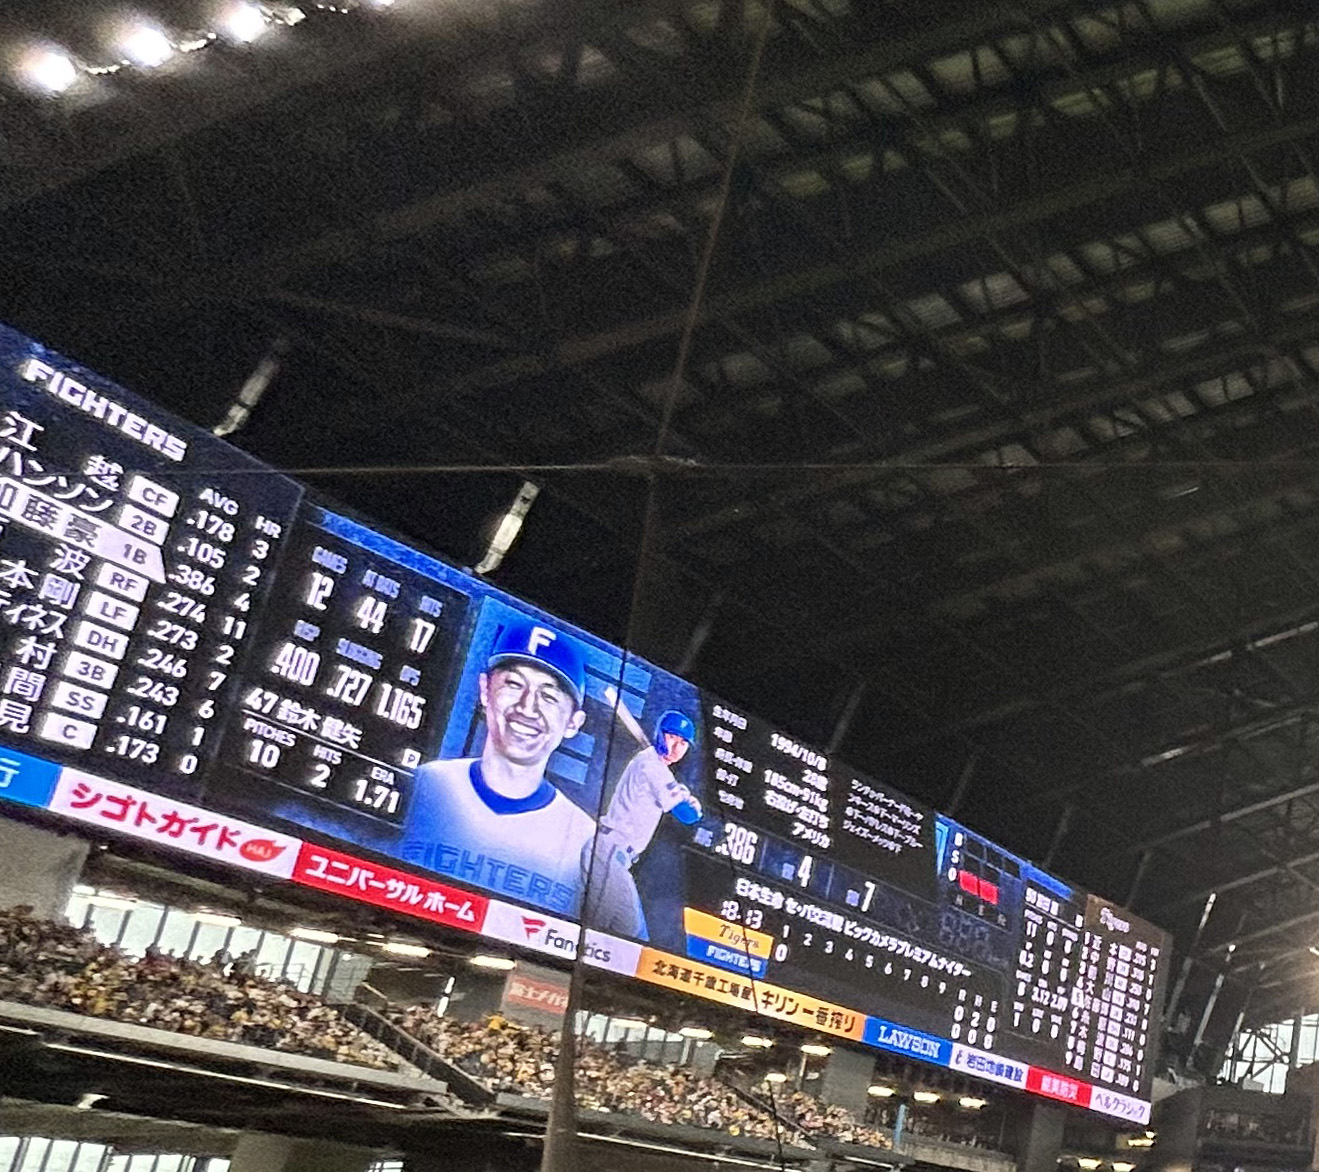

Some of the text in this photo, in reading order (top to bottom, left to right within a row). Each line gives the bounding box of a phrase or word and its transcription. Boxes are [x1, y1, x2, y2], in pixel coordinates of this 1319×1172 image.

[24, 358, 188, 461] FIGHTERS
[0, 447, 158, 536] ハンソン 2B
[142, 487, 169, 506] CF
[200, 488, 281, 539] AVG HR
[123, 543, 148, 565] 1B
[187, 511, 269, 559] .178 3
[109, 571, 138, 591] RF
[177, 537, 260, 586] .105 2
[168, 564, 250, 612] .386 4
[100, 601, 127, 621] LF
[158, 592, 247, 640] .274 11
[305, 571, 436, 653] 12 44 17
[16, 636, 106, 680] 村 3B
[87, 630, 119, 655] DH
[147, 620, 234, 665] .273 2
[527, 626, 557, 655] F
[137, 649, 227, 690] .246 7
[270, 643, 320, 686] .400
[326, 664, 373, 706] .727
[374, 683, 426, 730] 1.165
[67, 691, 96, 711] SS
[127, 677, 215, 719] .243 6
[246, 688, 279, 714] 47
[117, 706, 205, 746] .161 1
[106, 735, 199, 774] .173 0
[243, 717, 395, 785] PITCHES HITS ERA
[249, 740, 400, 814] 10 2 1.71
[69, 783, 242, 851] シゴトガイド
[304, 855, 477, 923] ユニバーサルホーム
[715, 823, 876, 912] .386 4 7
[761, 990, 856, 1033] キリン一番搾り
[878, 1025, 941, 1059] LAWSON
